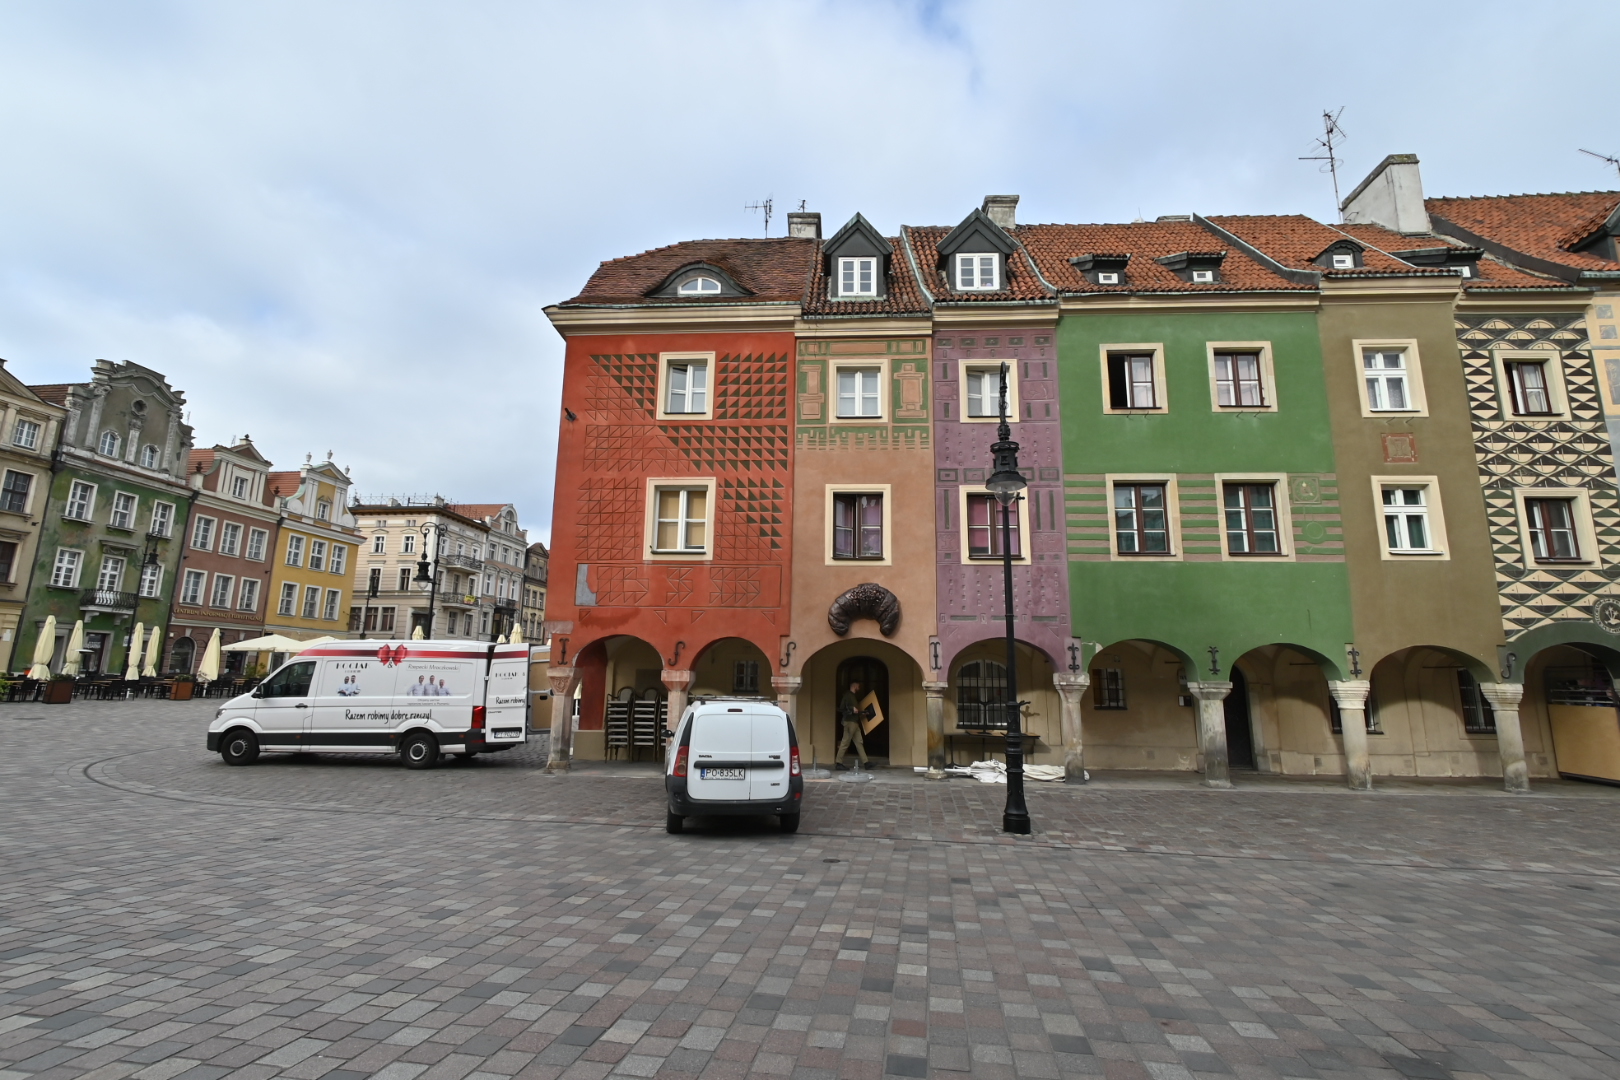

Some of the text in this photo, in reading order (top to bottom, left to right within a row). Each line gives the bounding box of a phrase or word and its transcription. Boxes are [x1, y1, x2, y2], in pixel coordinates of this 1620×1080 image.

[200, 611, 231, 619] INFORMACJI
[387, 661, 393, 669] &
[345, 708, 432, 725] Razem robimy dobre rzeczy!
[720, 768, 744, 777] 835LK
